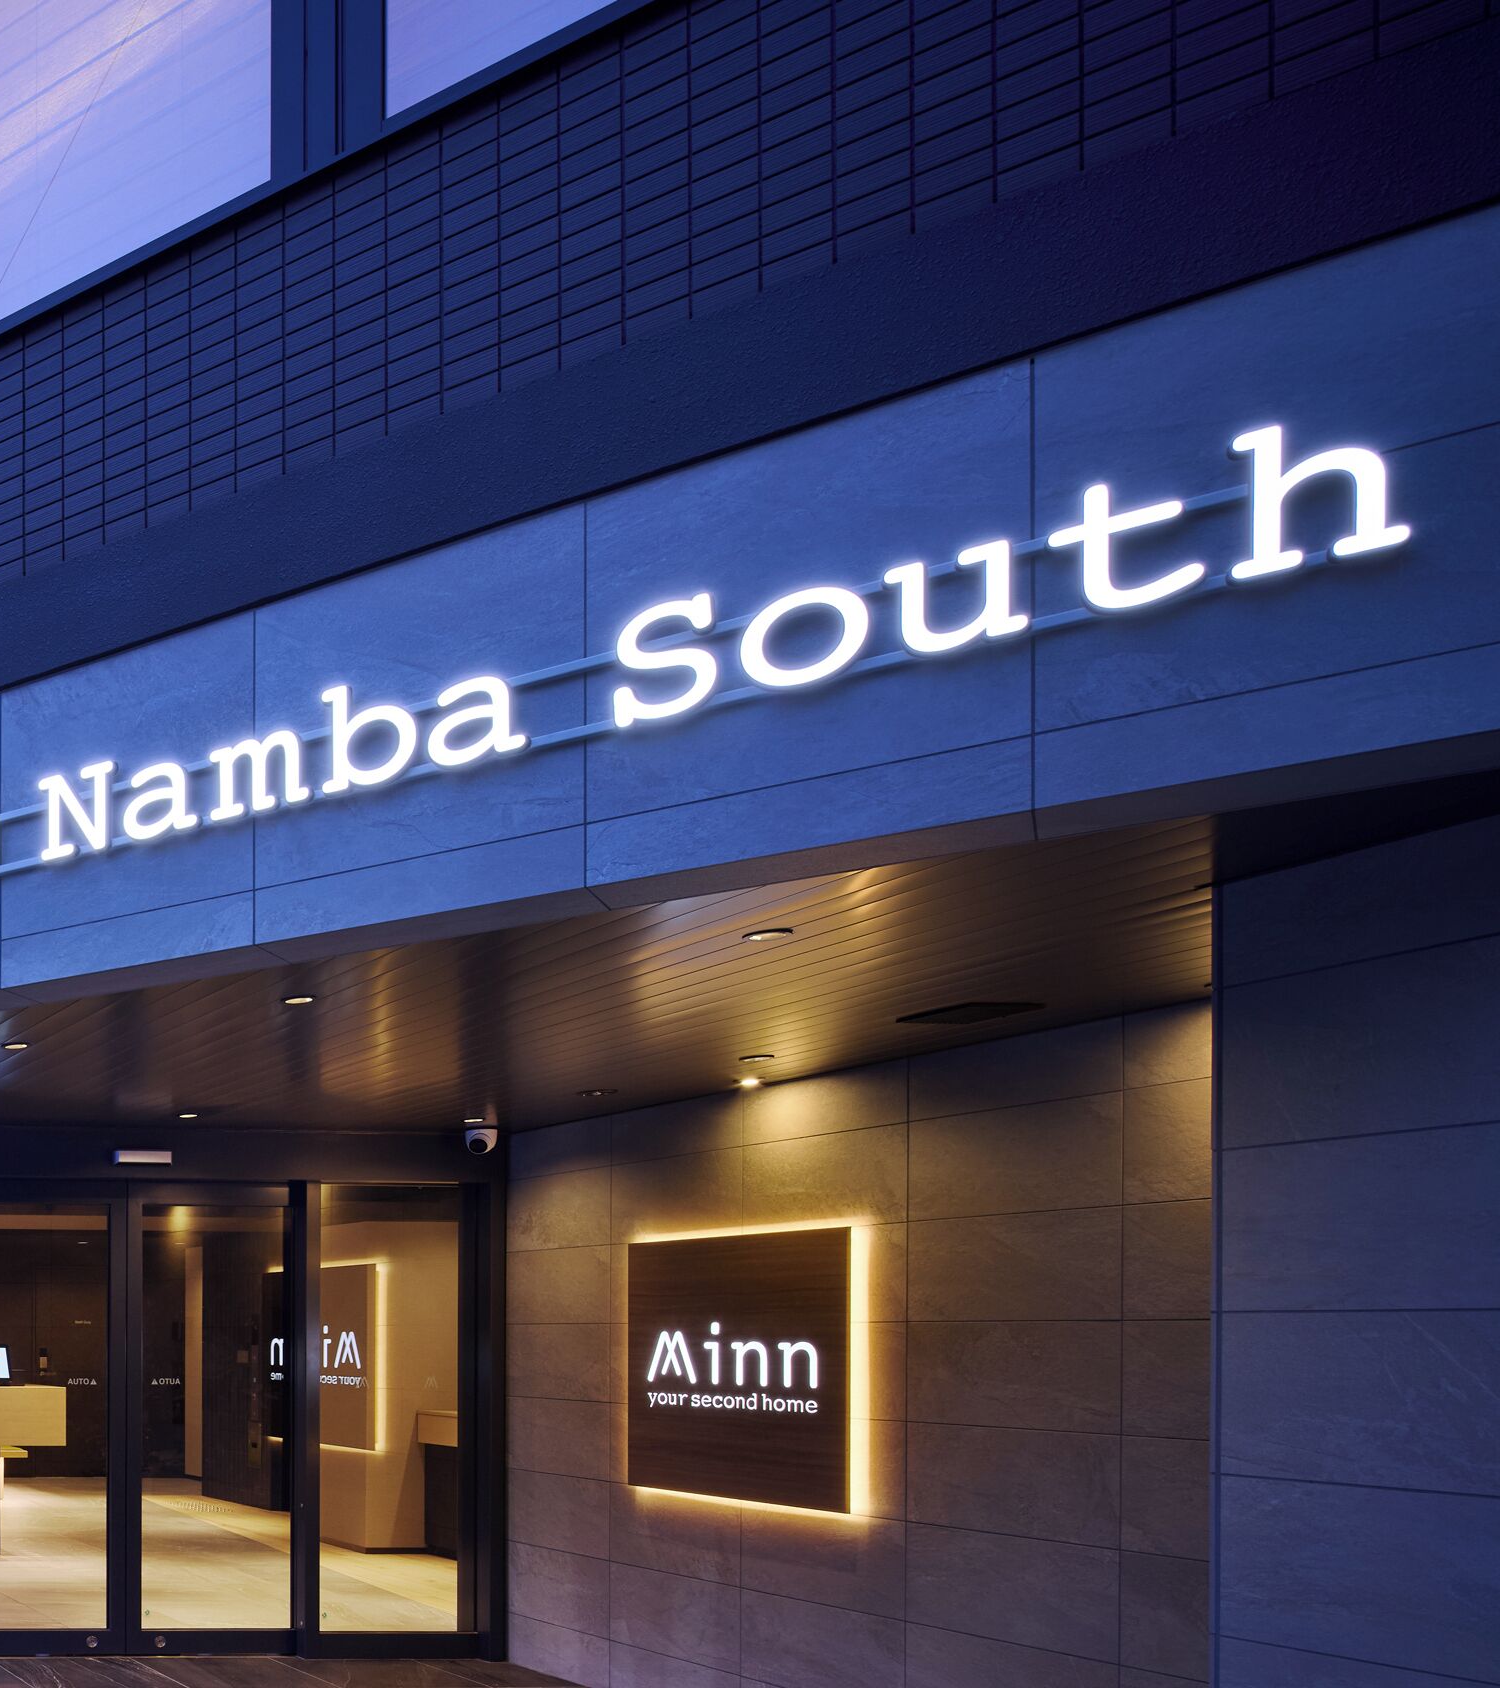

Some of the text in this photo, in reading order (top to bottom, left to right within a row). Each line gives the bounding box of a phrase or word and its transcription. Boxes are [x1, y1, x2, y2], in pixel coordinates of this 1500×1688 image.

[38, 674, 529, 861] Namba
[613, 425, 1410, 727] South
[647, 1321, 818, 1389] Minn
[647, 1392, 818, 1413] your second home
